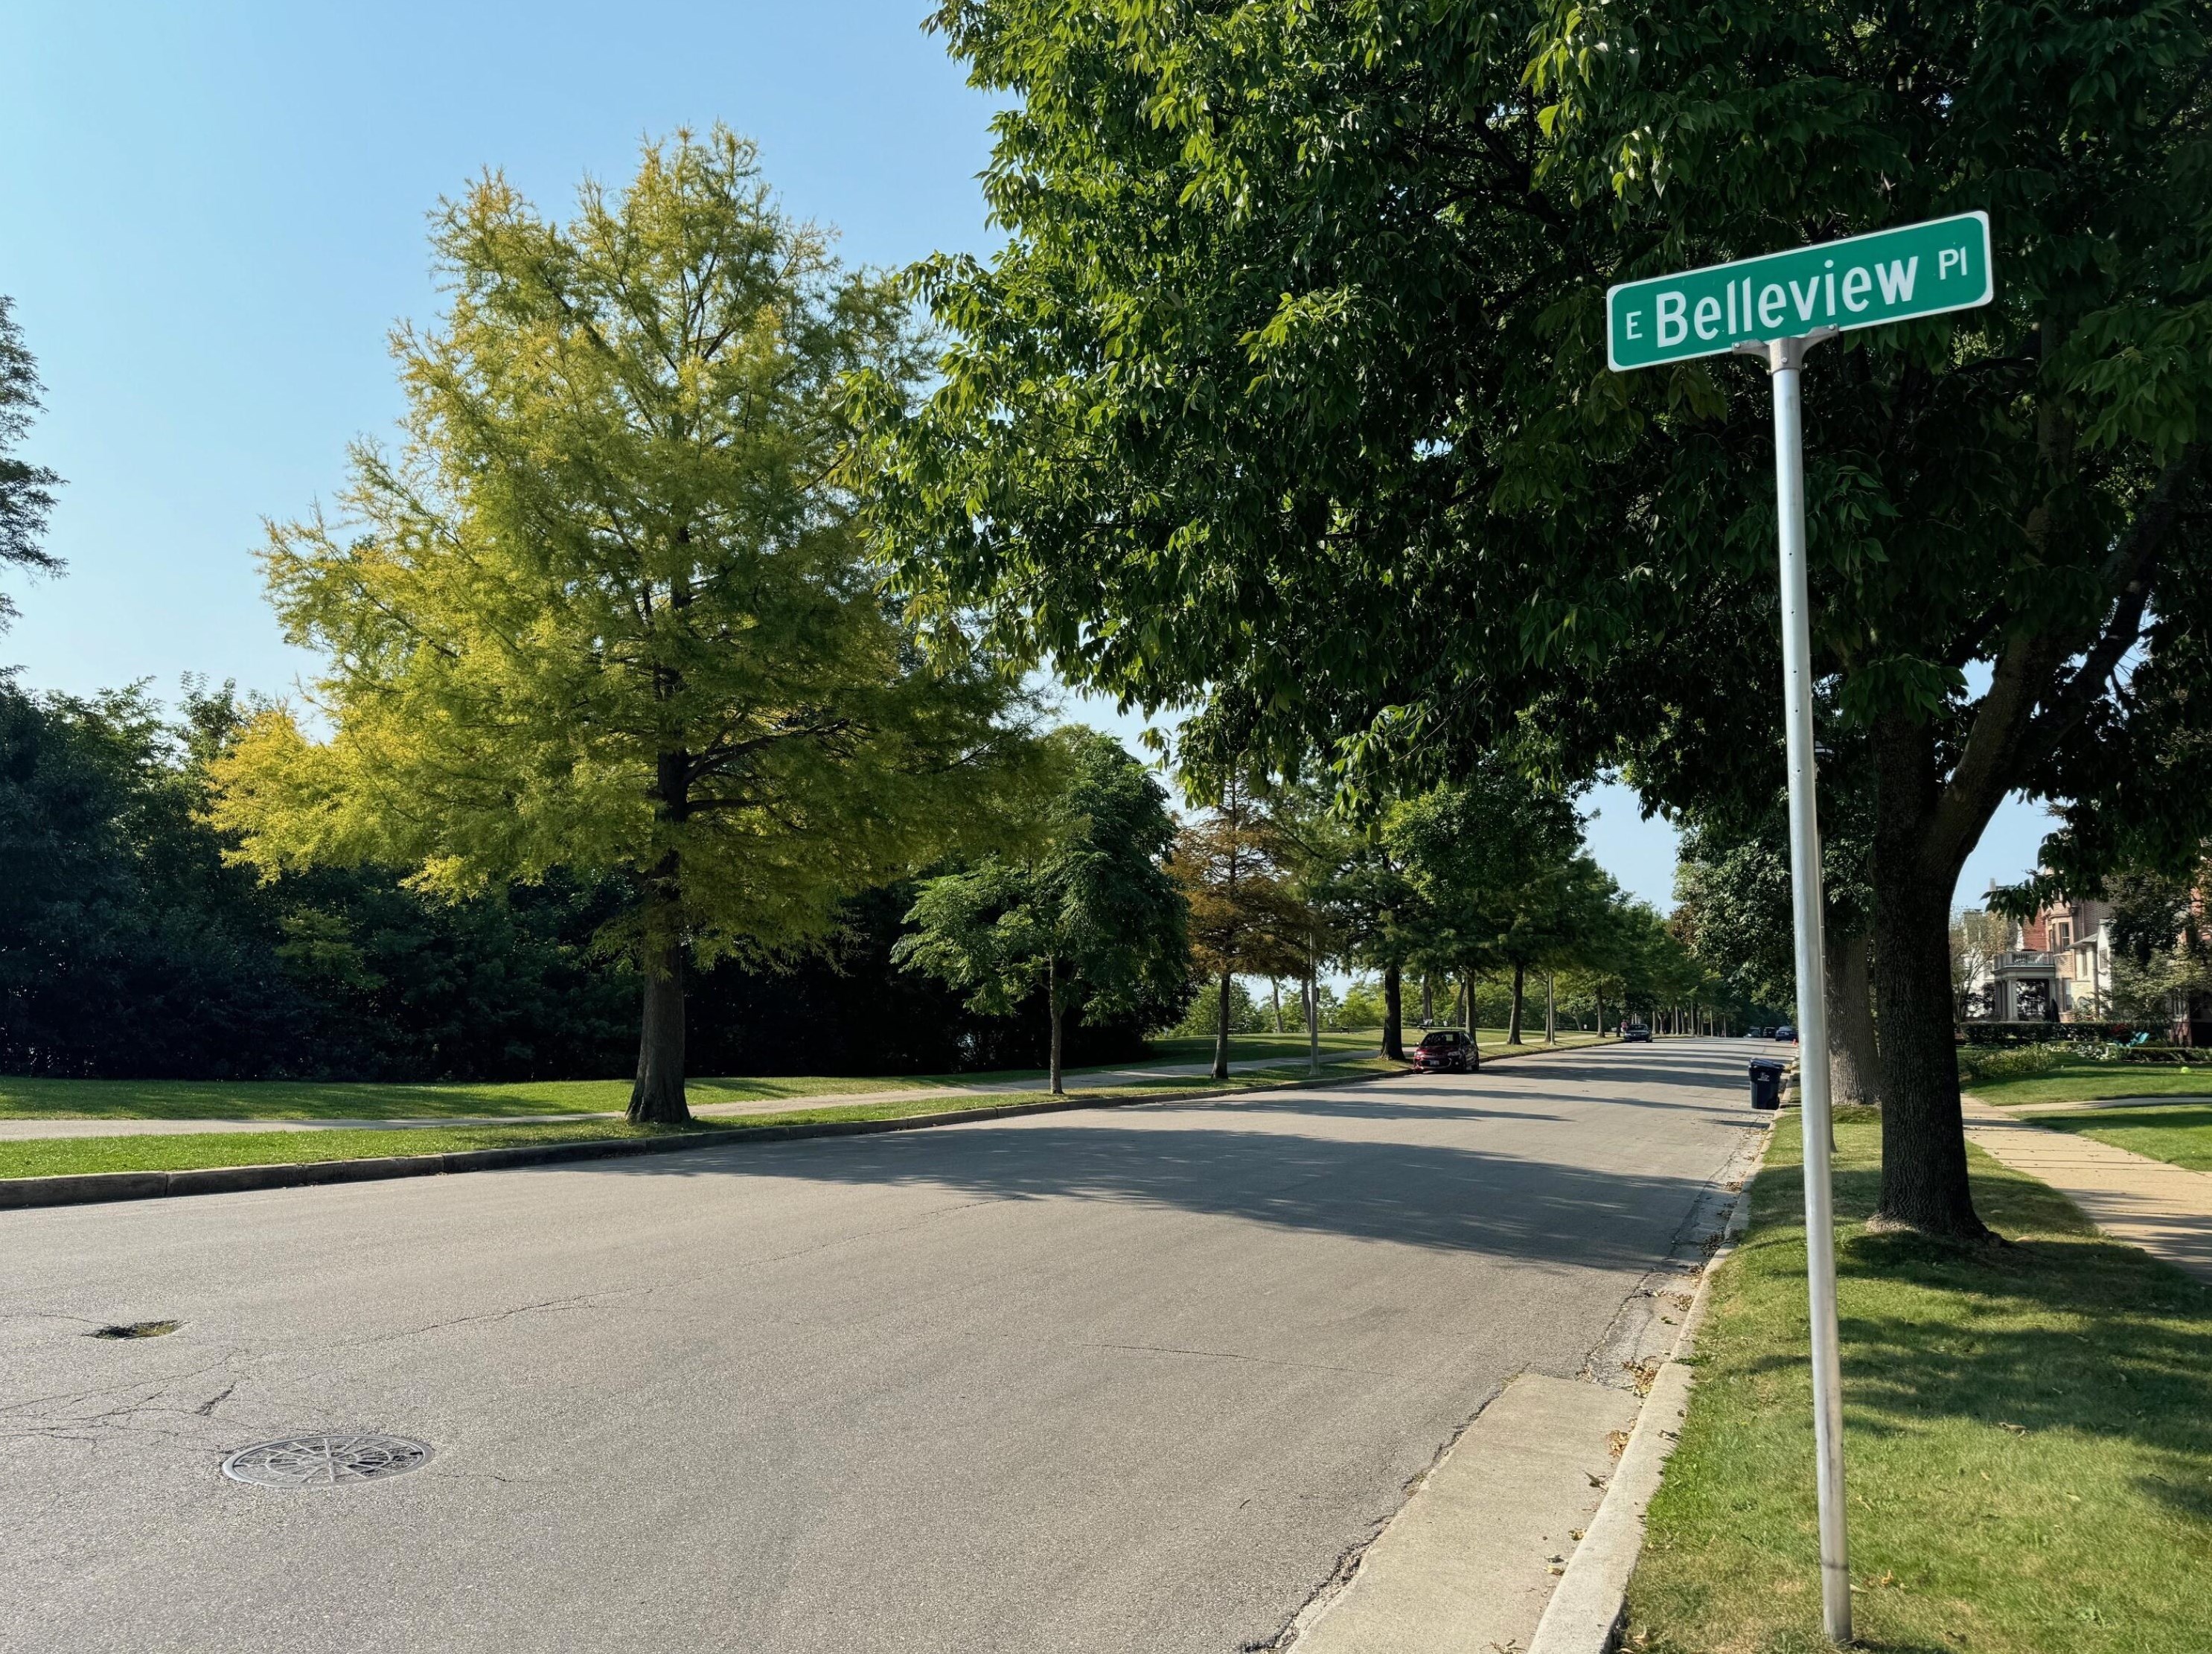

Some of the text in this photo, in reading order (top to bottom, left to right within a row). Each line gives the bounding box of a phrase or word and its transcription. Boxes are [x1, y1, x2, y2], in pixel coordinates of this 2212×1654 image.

[1626, 246, 1967, 348] E Belleview Pl
